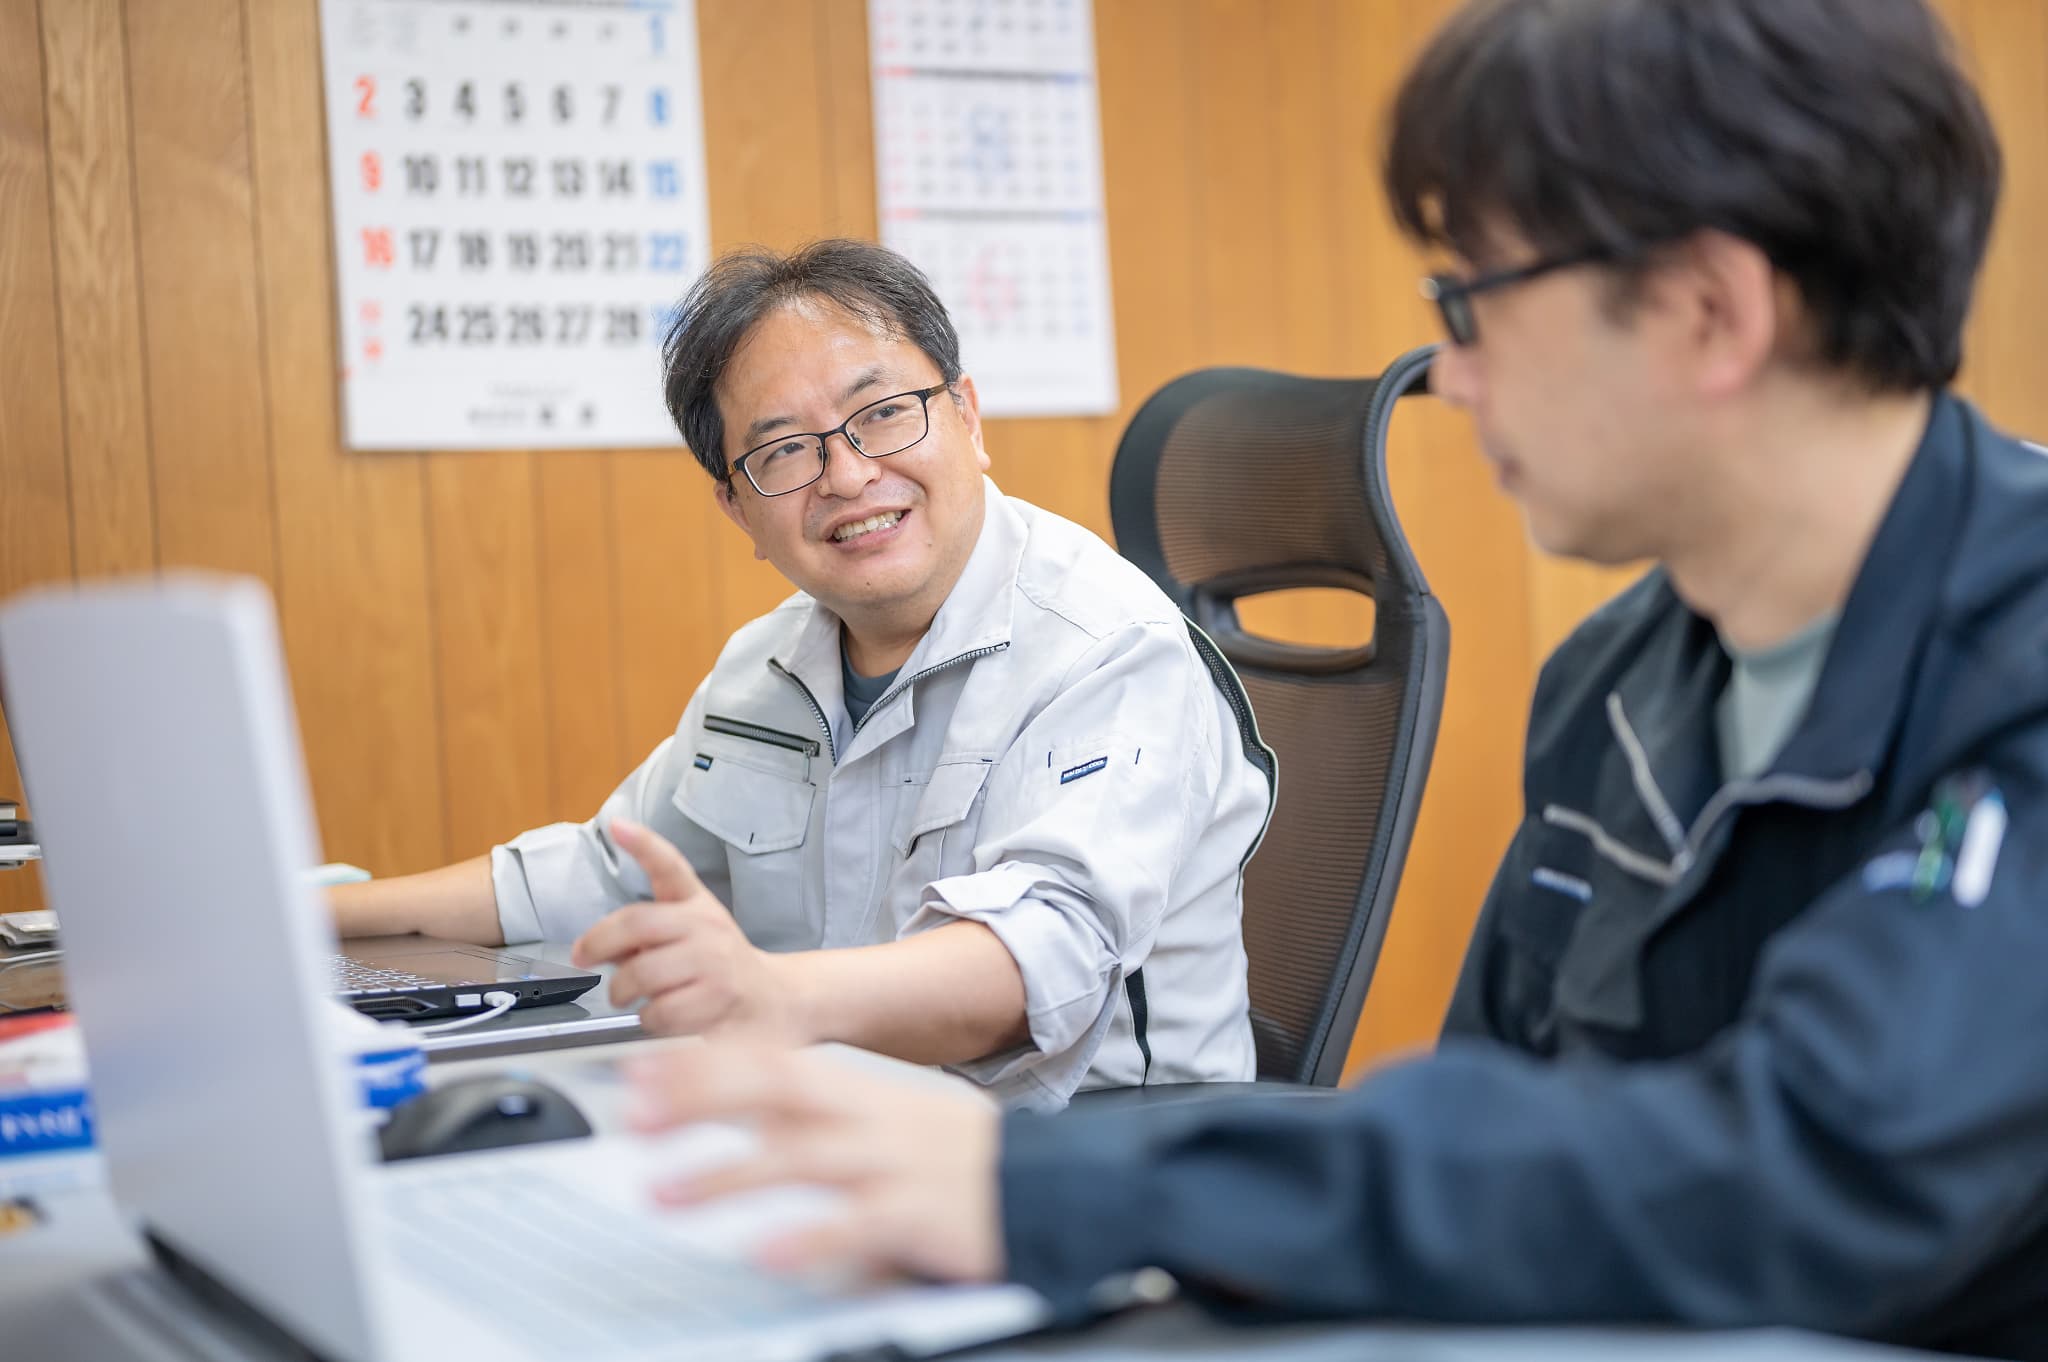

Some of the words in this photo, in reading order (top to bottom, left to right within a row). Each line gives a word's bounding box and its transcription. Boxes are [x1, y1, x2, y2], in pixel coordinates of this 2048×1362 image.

[355, 75, 376, 117] 2
[406, 79, 426, 120] 3
[455, 80, 477, 121] 4
[504, 83, 525, 122] 5
[553, 85, 572, 123] 6
[603, 85, 621, 124] 7
[361, 152, 381, 191] 9
[403, 155, 439, 195] 10
[455, 156, 486, 194] 11
[502, 158, 535, 197] 12
[552, 160, 584, 196] 13
[600, 160, 634, 197] 14
[361, 228, 395, 267] 16
[408, 229, 440, 268] 17
[457, 232, 491, 270] 18
[506, 232, 540, 270] 19
[551, 233, 590, 270] 20
[602, 233, 638, 271] 21
[410, 306, 448, 342] 24
[458, 306, 497, 344] 25
[507, 307, 545, 343] 26
[556, 306, 593, 344] 27
